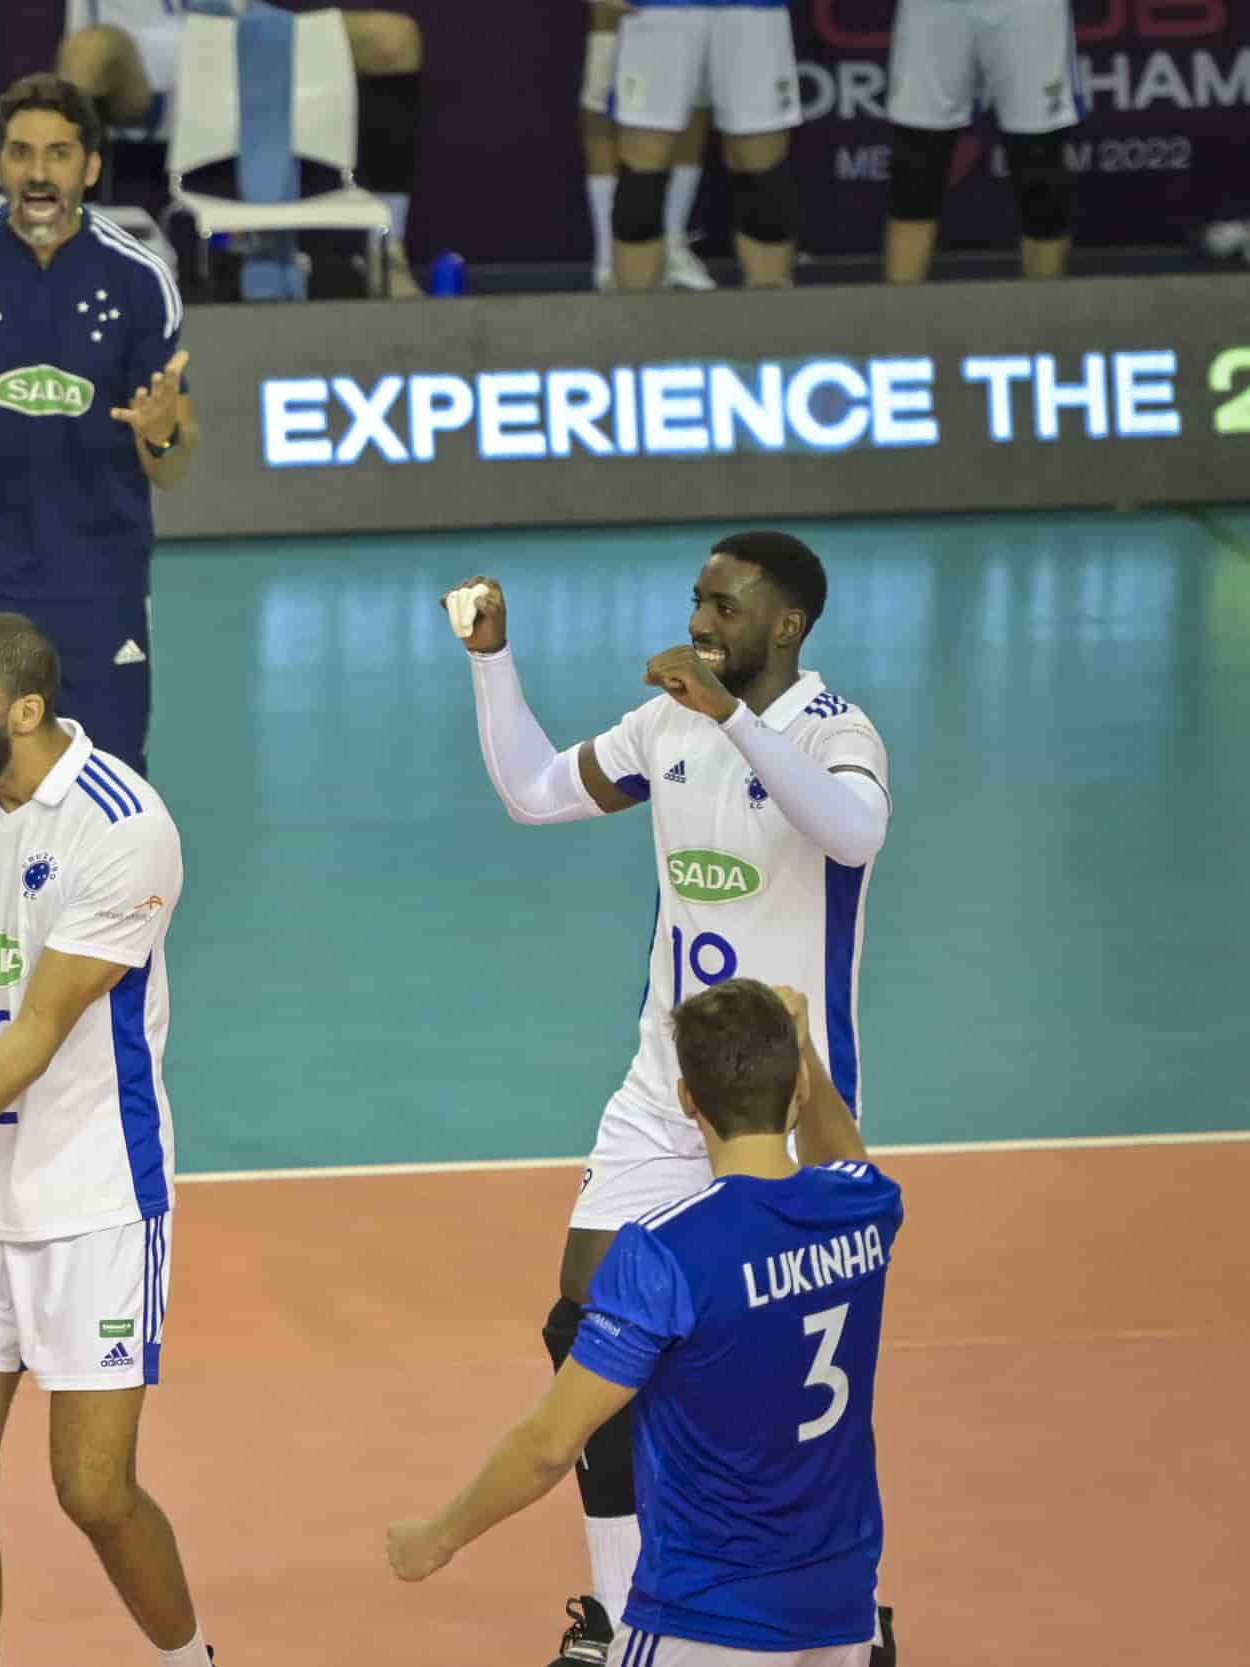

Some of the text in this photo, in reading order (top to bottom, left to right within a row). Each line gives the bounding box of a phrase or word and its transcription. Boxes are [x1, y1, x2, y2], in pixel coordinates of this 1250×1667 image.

[1099, 138, 1190, 172] 2022
[8, 378, 82, 406] SADA
[261, 356, 940, 468] EXPERIENCE
[961, 349, 1181, 441] THE
[670, 859, 748, 892] SADA
[742, 1224, 885, 1309] LUKINHA
[100, 1357, 134, 1367] adidas
[798, 1302, 850, 1443] 3
